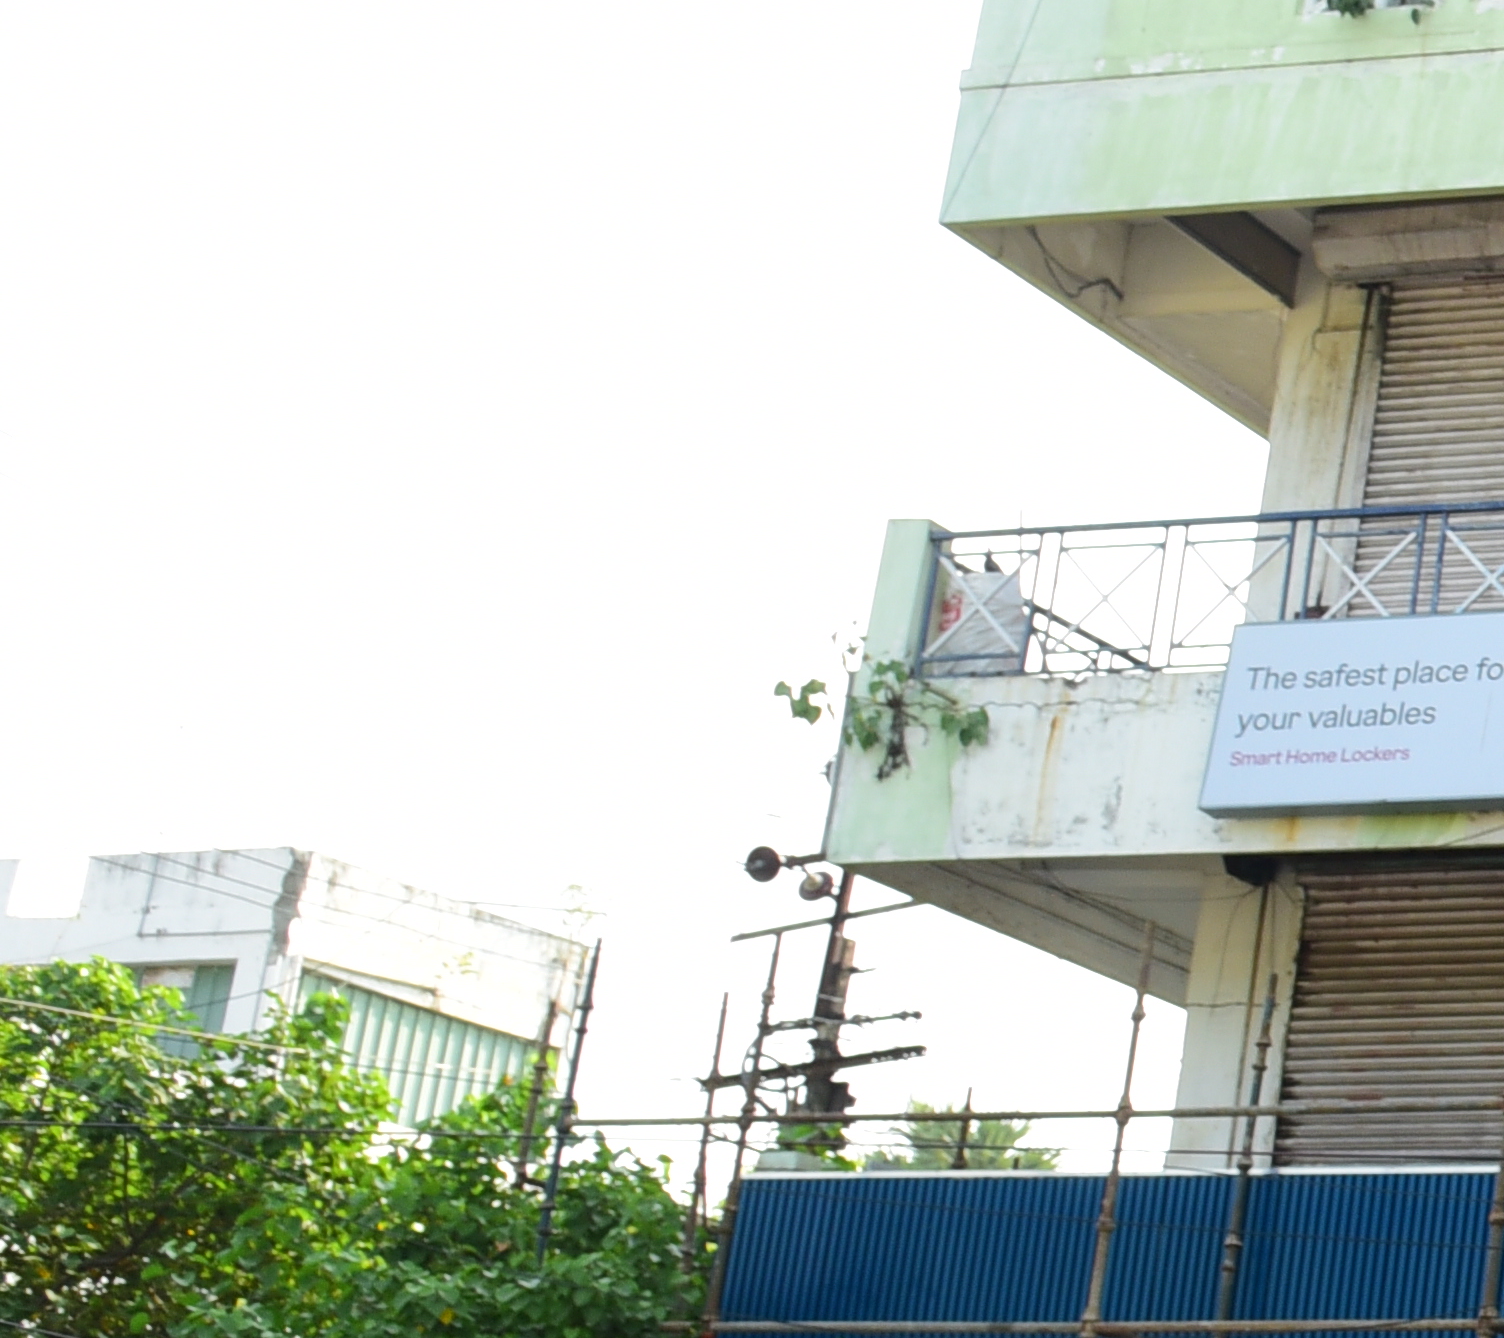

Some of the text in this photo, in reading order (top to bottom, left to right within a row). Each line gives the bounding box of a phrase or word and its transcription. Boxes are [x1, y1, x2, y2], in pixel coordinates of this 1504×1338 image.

[1247, 665, 1298, 691] The
[1303, 660, 1387, 691] safest
[1392, 657, 1469, 692] place
[1235, 700, 1436, 738] your valuables
[1229, 744, 1411, 767] Smart Home Lockers
